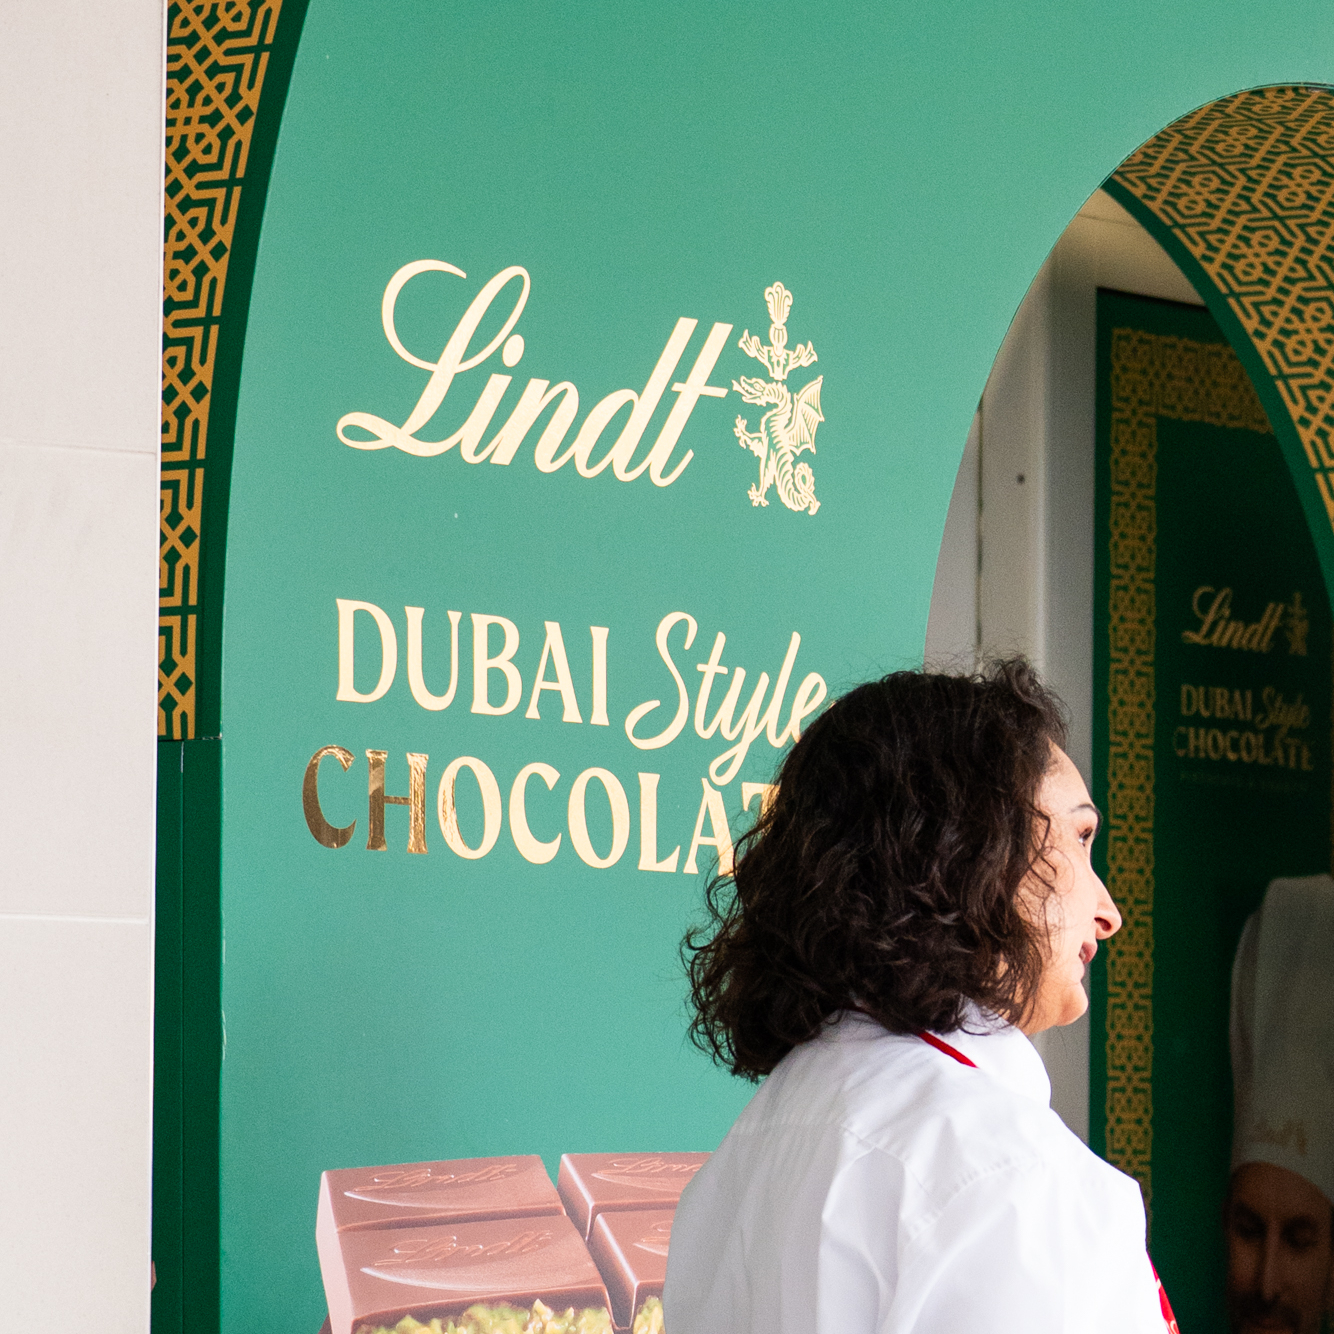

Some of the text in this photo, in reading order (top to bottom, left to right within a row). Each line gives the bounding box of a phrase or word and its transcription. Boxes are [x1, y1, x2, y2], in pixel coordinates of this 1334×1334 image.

[336, 259, 733, 488] Lindt
[1181, 585, 1286, 654] Lindt
[336, 598, 836, 786] DUBAI Style
[1180, 683, 1253, 722] DUBAI
[302, 744, 782, 877] CHOCOLAT
